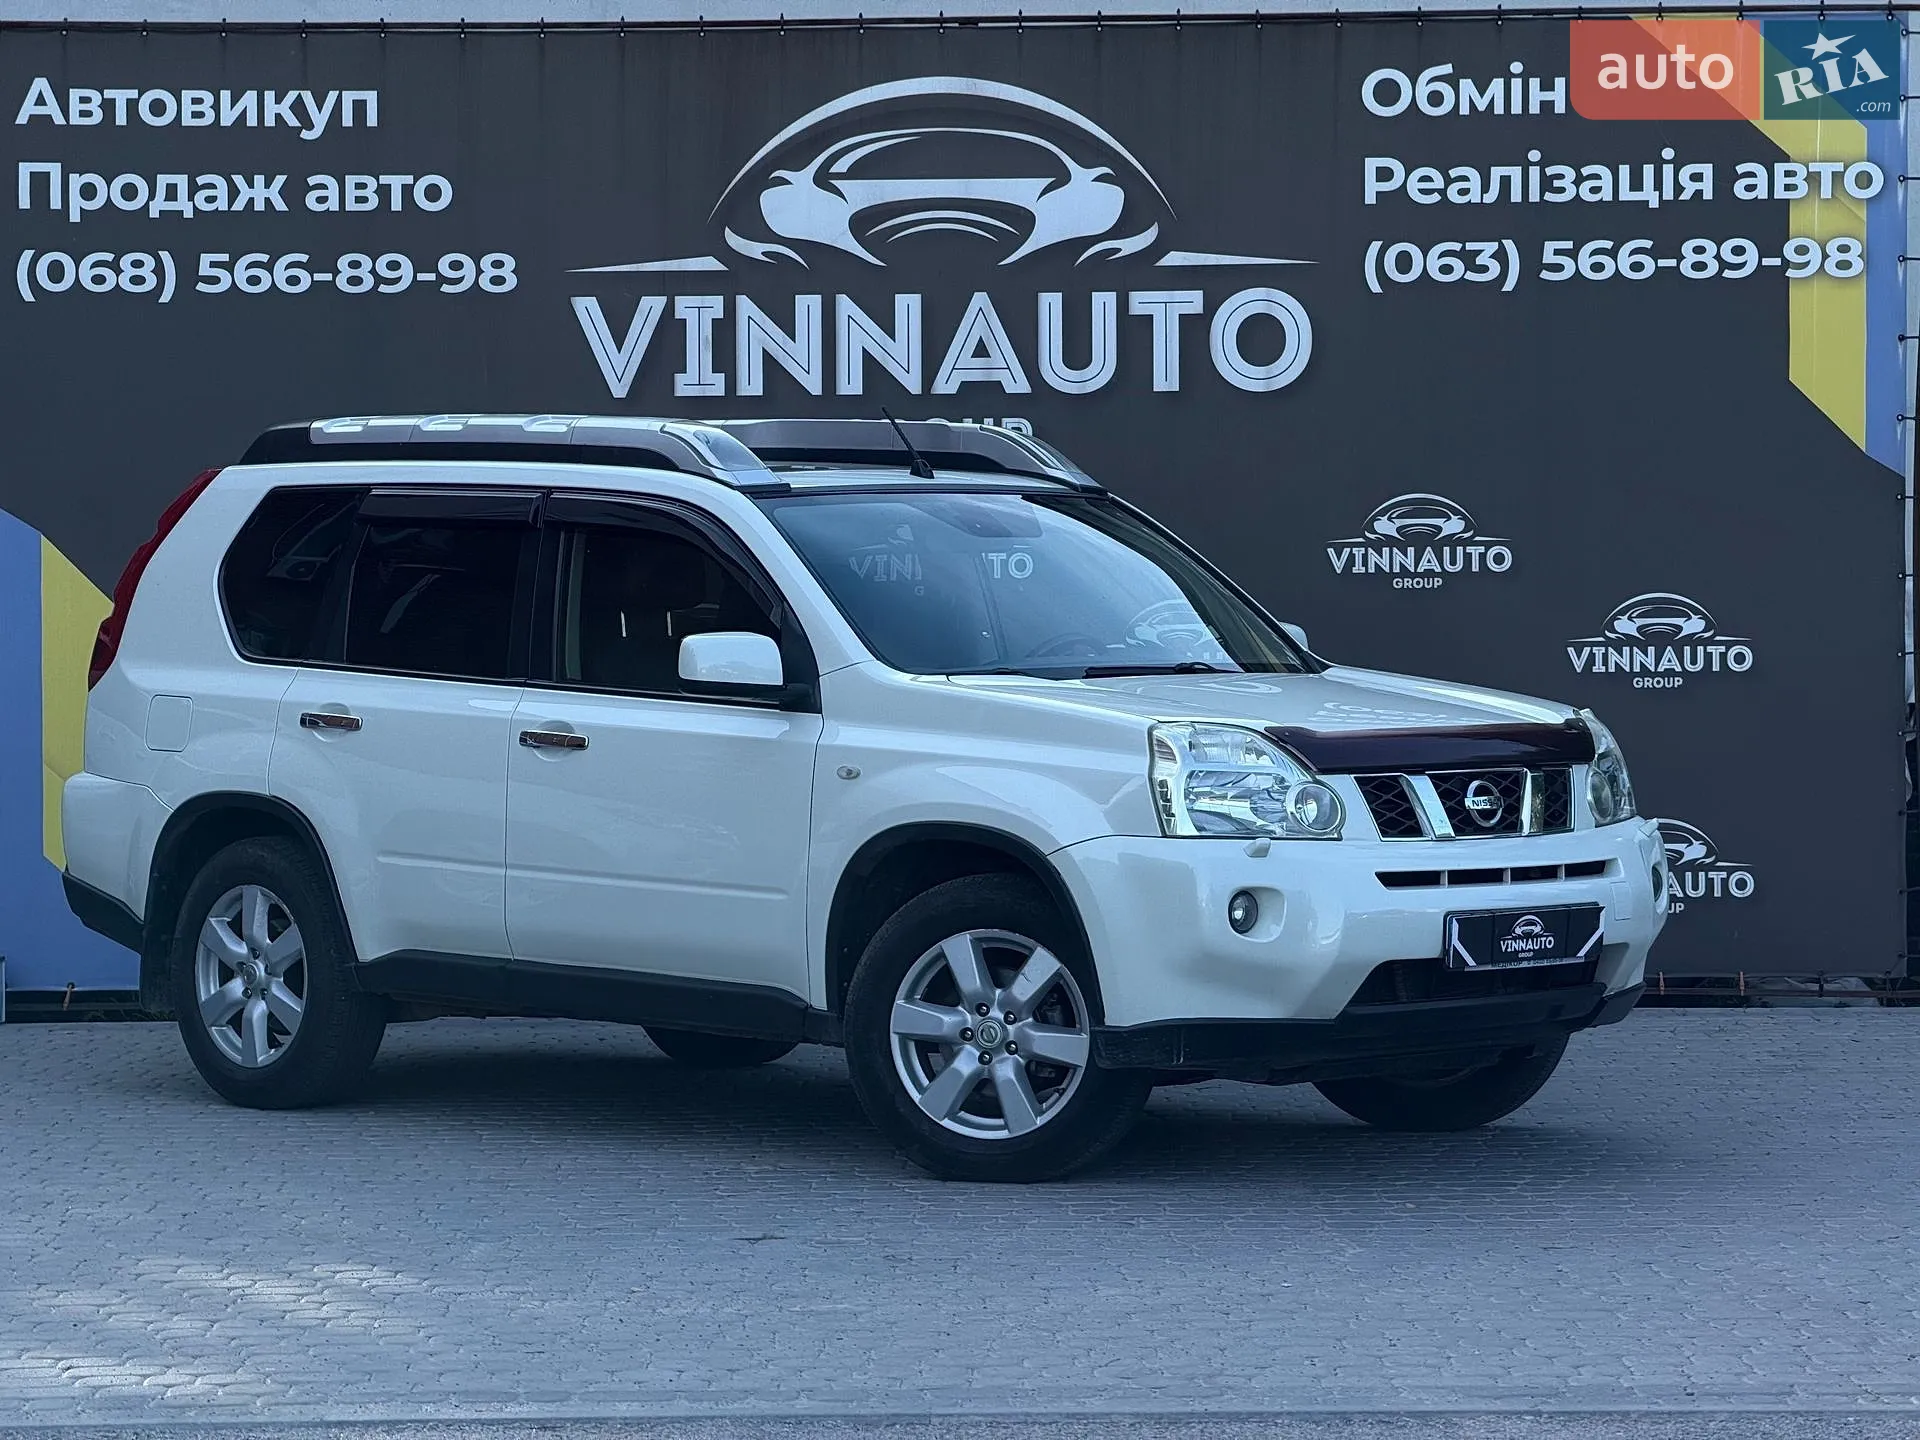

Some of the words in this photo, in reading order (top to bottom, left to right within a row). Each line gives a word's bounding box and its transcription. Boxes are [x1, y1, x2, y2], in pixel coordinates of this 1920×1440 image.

[15, 77, 378, 140] Автовикуп
[1361, 61, 1566, 117] Обмін
[18, 161, 289, 222] Продаж
[304, 174, 453, 212] авто
[1364, 147, 1714, 208] Реалізація
[1733, 161, 1884, 200] авто
[16, 249, 177, 303] (068)
[195, 252, 518, 294] 566-89-98
[1364, 239, 1520, 293] (063)
[1539, 237, 1865, 281] 566-89-98
[571, 287, 1313, 399] VINNAUTO
[1327, 545, 1513, 574] VINNAUTO
[1392, 577, 1443, 589] GROUP
[1567, 645, 1753, 673] VINNAUTO
[1632, 677, 1683, 689] GROUP
[1500, 936, 1555, 953] VINNAUTO
